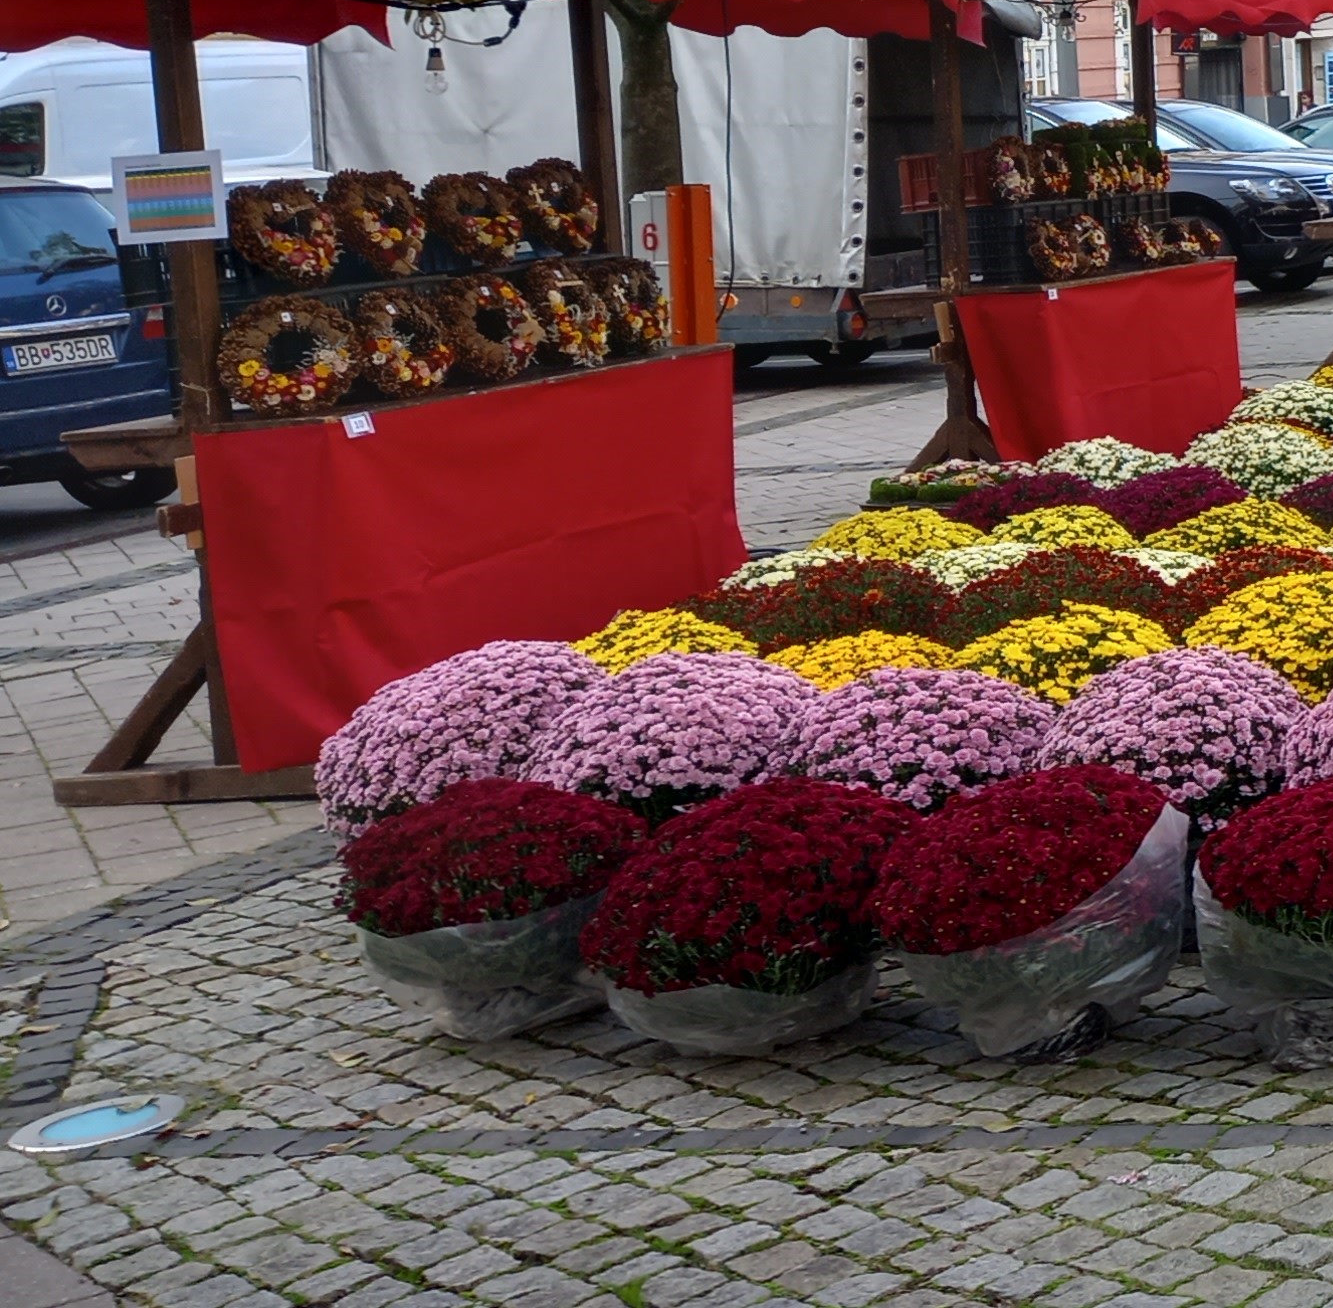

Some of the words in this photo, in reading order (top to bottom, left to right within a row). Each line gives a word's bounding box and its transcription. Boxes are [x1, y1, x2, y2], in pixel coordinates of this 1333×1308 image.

[643, 224, 658, 251] 6
[16, 346, 42, 367] BB
[50, 337, 112, 363] 535DR
